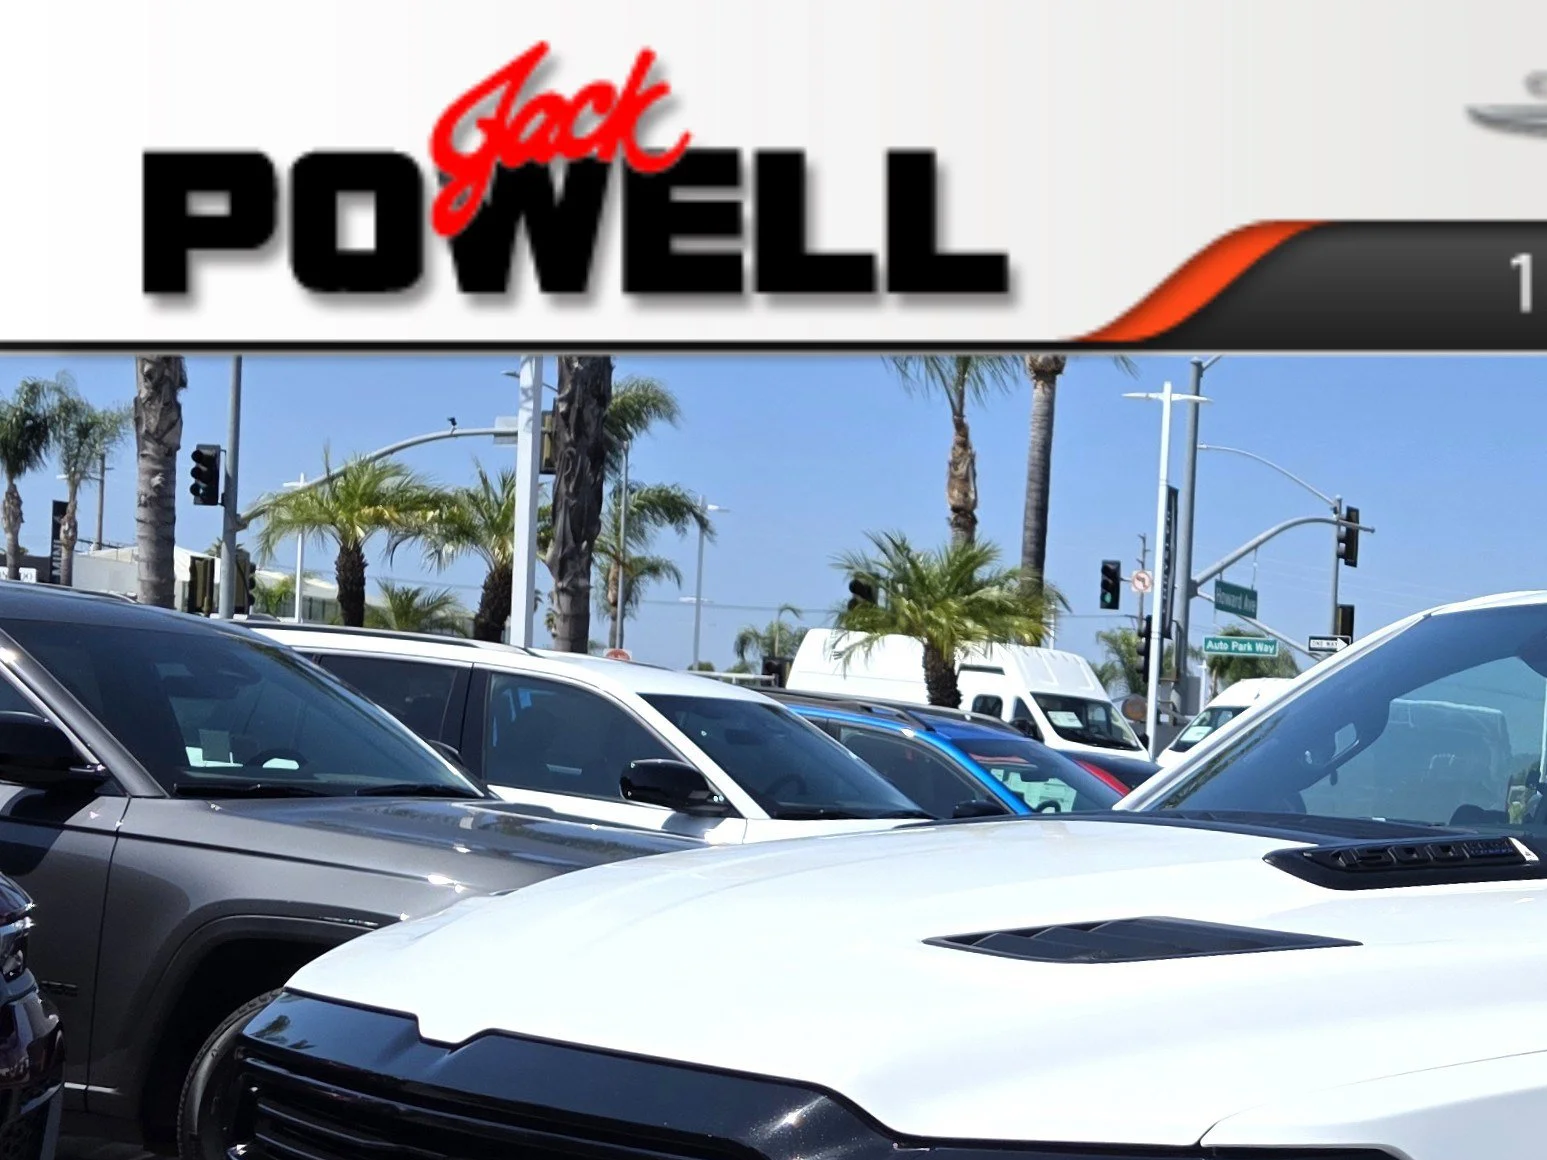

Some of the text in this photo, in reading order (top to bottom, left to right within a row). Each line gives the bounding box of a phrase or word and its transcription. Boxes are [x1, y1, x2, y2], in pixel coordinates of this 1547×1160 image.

[1206, 640, 1275, 654] Auto Park Way
